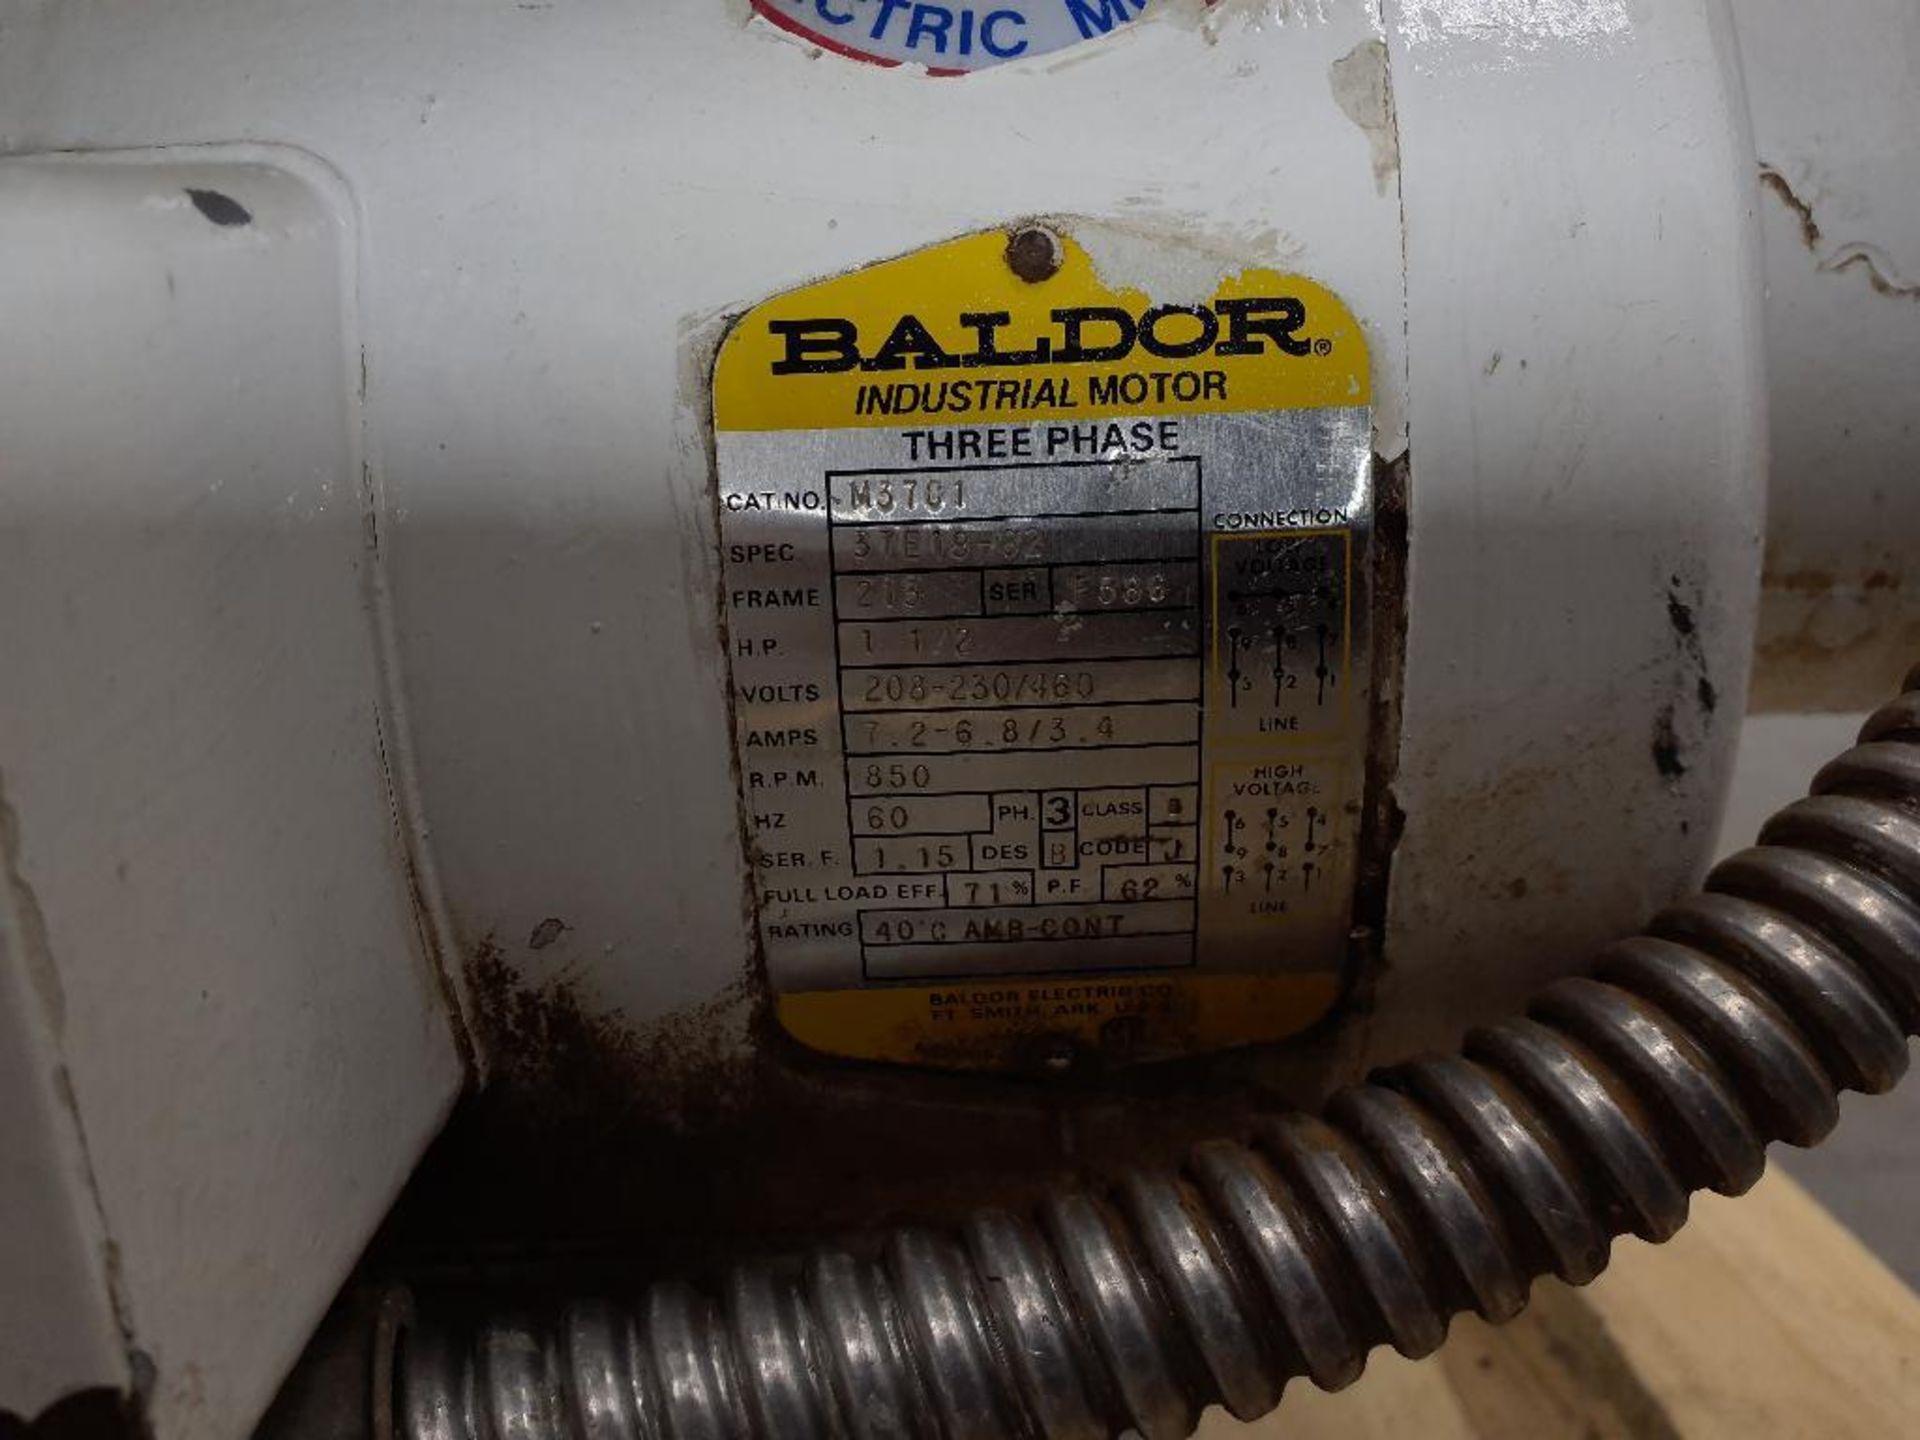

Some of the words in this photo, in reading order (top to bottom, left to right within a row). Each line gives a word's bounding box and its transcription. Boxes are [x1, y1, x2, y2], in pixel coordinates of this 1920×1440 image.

[769, 298, 1312, 376] BALDOR
[855, 377, 1079, 416] INDUSTRIAL
[1089, 371, 1228, 406] MOTOR
[902, 427, 1032, 461] THREE
[1048, 421, 1179, 456] PHASE
[1214, 508, 1348, 530] CONNECTION
[730, 543, 795, 564] SPEC
[732, 588, 821, 609] FRAME
[989, 581, 1037, 602] SER
[741, 684, 820, 703] VOLTS
[865, 671, 1095, 702] 208-230/460
[746, 729, 818, 747] AMPS
[1259, 717, 1300, 732] LINE
[865, 764, 931, 788] 850
[1254, 764, 1304, 779] HIGH
[755, 813, 788, 829] HZ
[867, 805, 909, 830] 60
[998, 805, 1036, 822] PH.
[1046, 796, 1072, 826] 3
[1081, 801, 1144, 818] CLASS
[877, 845, 954, 870] 1.15
[981, 844, 1029, 861] DES
[1079, 840, 1147, 856] CODE
[763, 888, 819, 906] FULL
[825, 884, 888, 902] LOAD
[1120, 878, 1160, 901] 62
[768, 922, 854, 940] RATING
